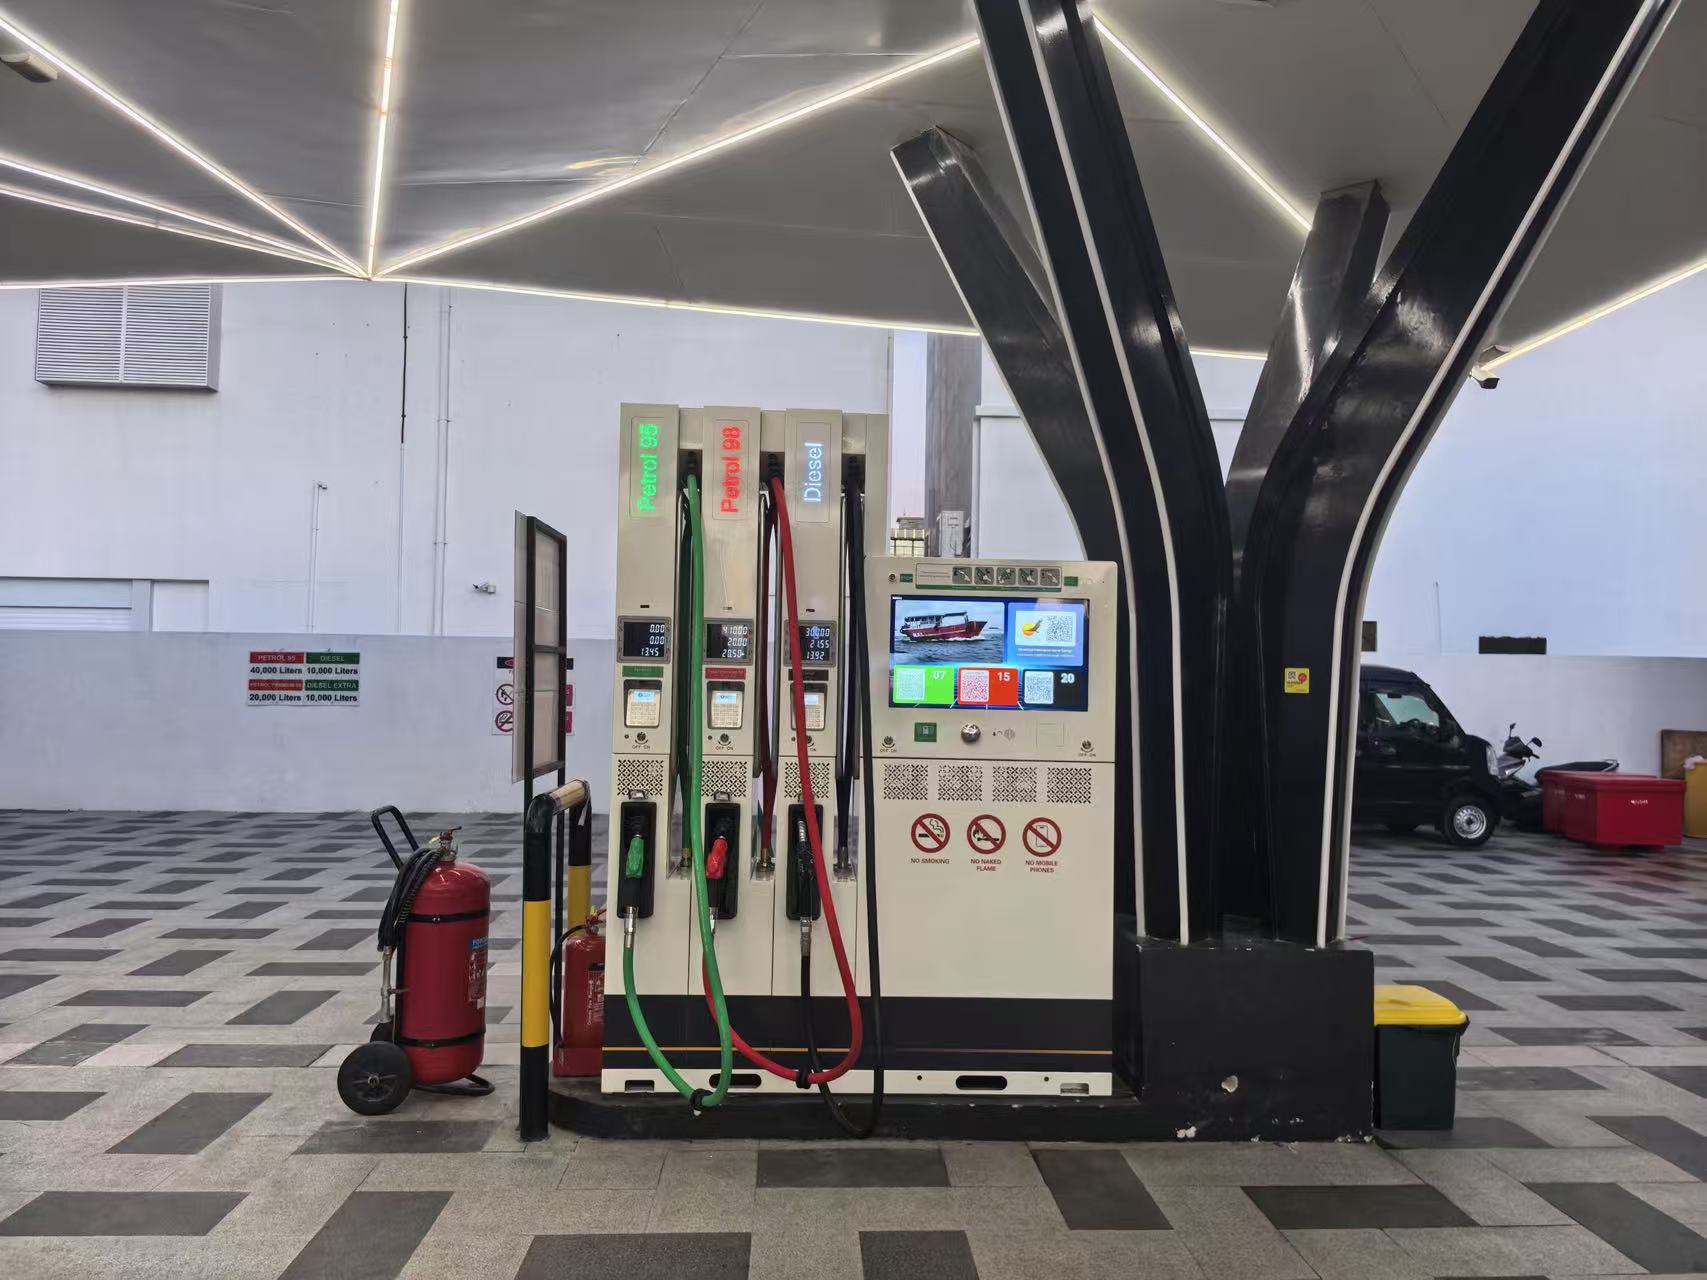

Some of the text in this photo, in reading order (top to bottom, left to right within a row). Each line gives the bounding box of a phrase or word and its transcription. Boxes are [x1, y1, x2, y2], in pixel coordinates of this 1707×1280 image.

[638, 424, 658, 512] Petrol 95
[721, 426, 742, 512] Petrol 98
[804, 442, 823, 502] Diesel
[650, 624, 665, 633] 0.00
[649, 636, 664, 644] 0.00
[728, 638, 747, 646] 20.00
[641, 648, 659, 656] 13.45
[807, 651, 824, 660] 13.92
[250, 666, 277, 675] 40,000
[307, 667, 332, 675] 10,000
[997, 672, 1010, 682] 15
[1061, 673, 1075, 683] 20
